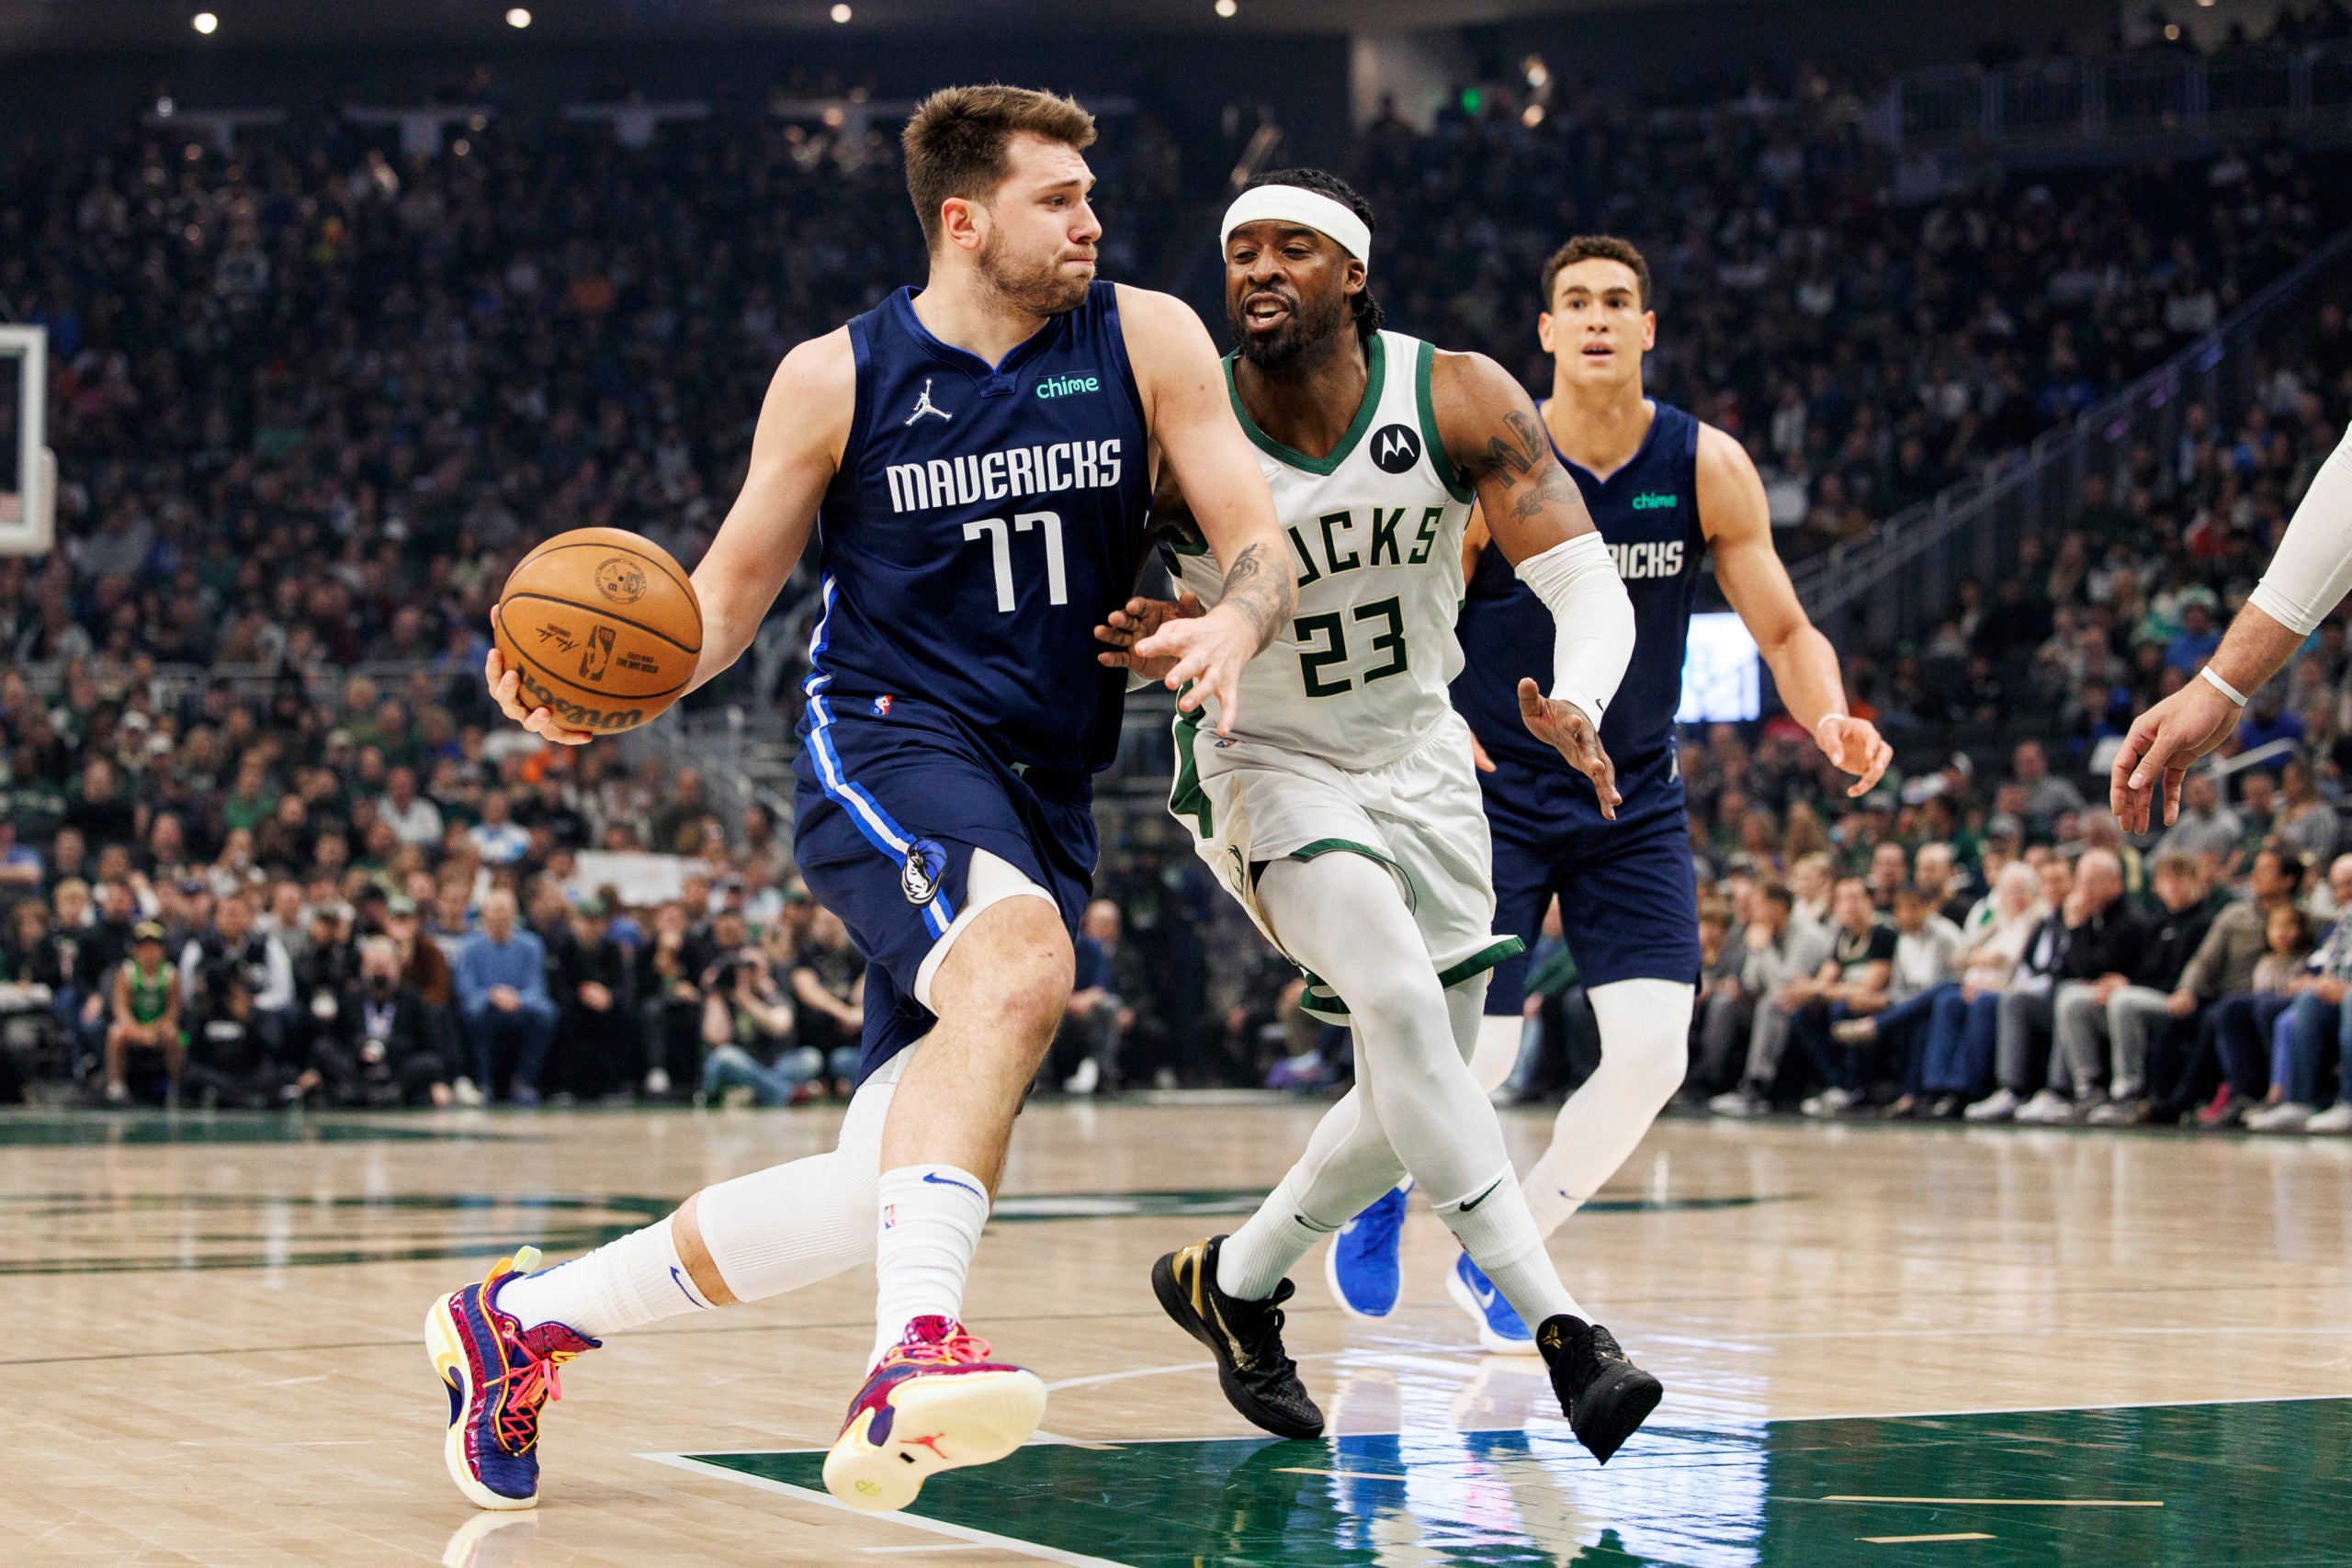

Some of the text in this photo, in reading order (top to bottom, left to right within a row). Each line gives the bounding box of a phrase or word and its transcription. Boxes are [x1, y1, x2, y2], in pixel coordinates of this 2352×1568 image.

[1035, 375, 1100, 400] chime
[886, 438, 1122, 513] MAVERICKS
[1632, 491, 1678, 510] chime
[962, 510, 1068, 614] 77
[1286, 505, 1444, 589] UCKS
[1292, 593, 1409, 699] 23
